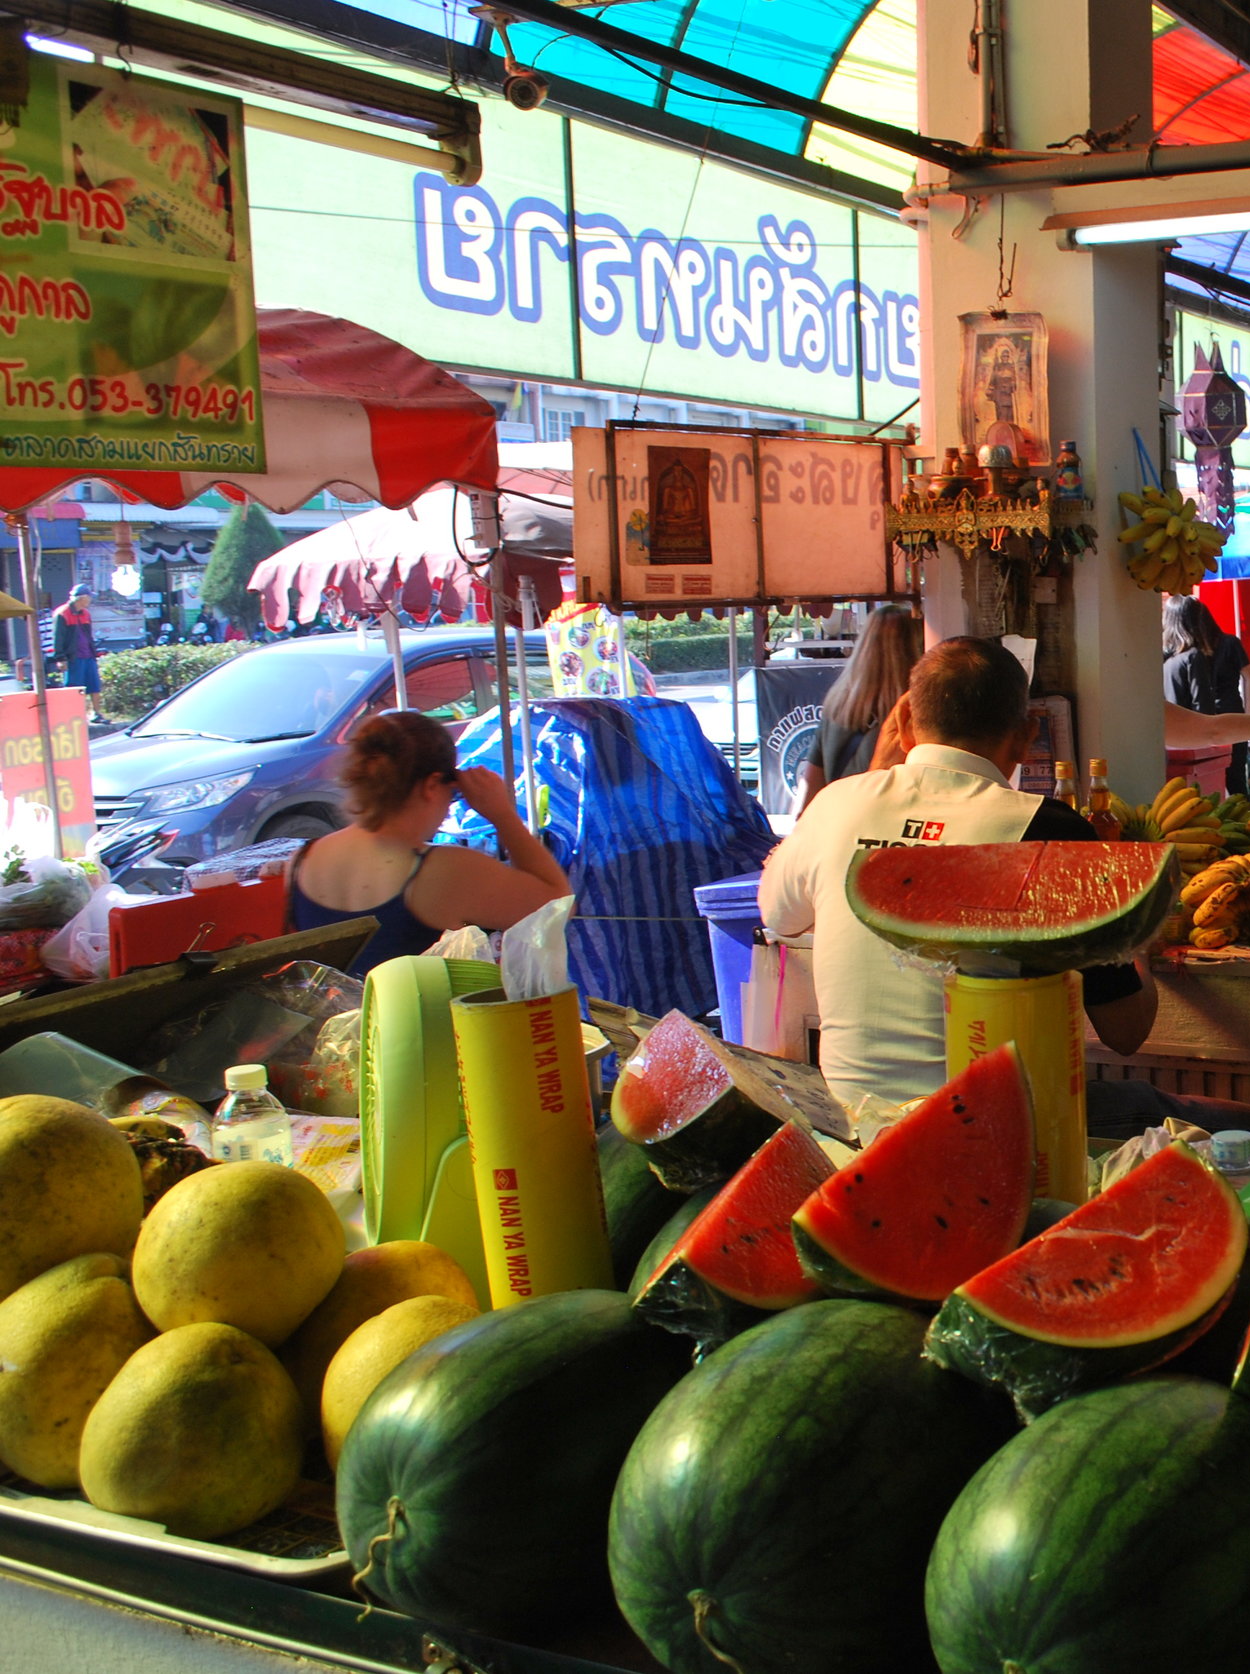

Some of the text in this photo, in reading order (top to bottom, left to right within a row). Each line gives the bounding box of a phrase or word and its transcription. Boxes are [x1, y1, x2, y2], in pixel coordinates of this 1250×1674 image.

[1, 361, 255, 422] โทร.053-379491
[529, 1008, 564, 1114] NAN YA WRAP
[497, 1195, 533, 1298] NAN YA WRAP
